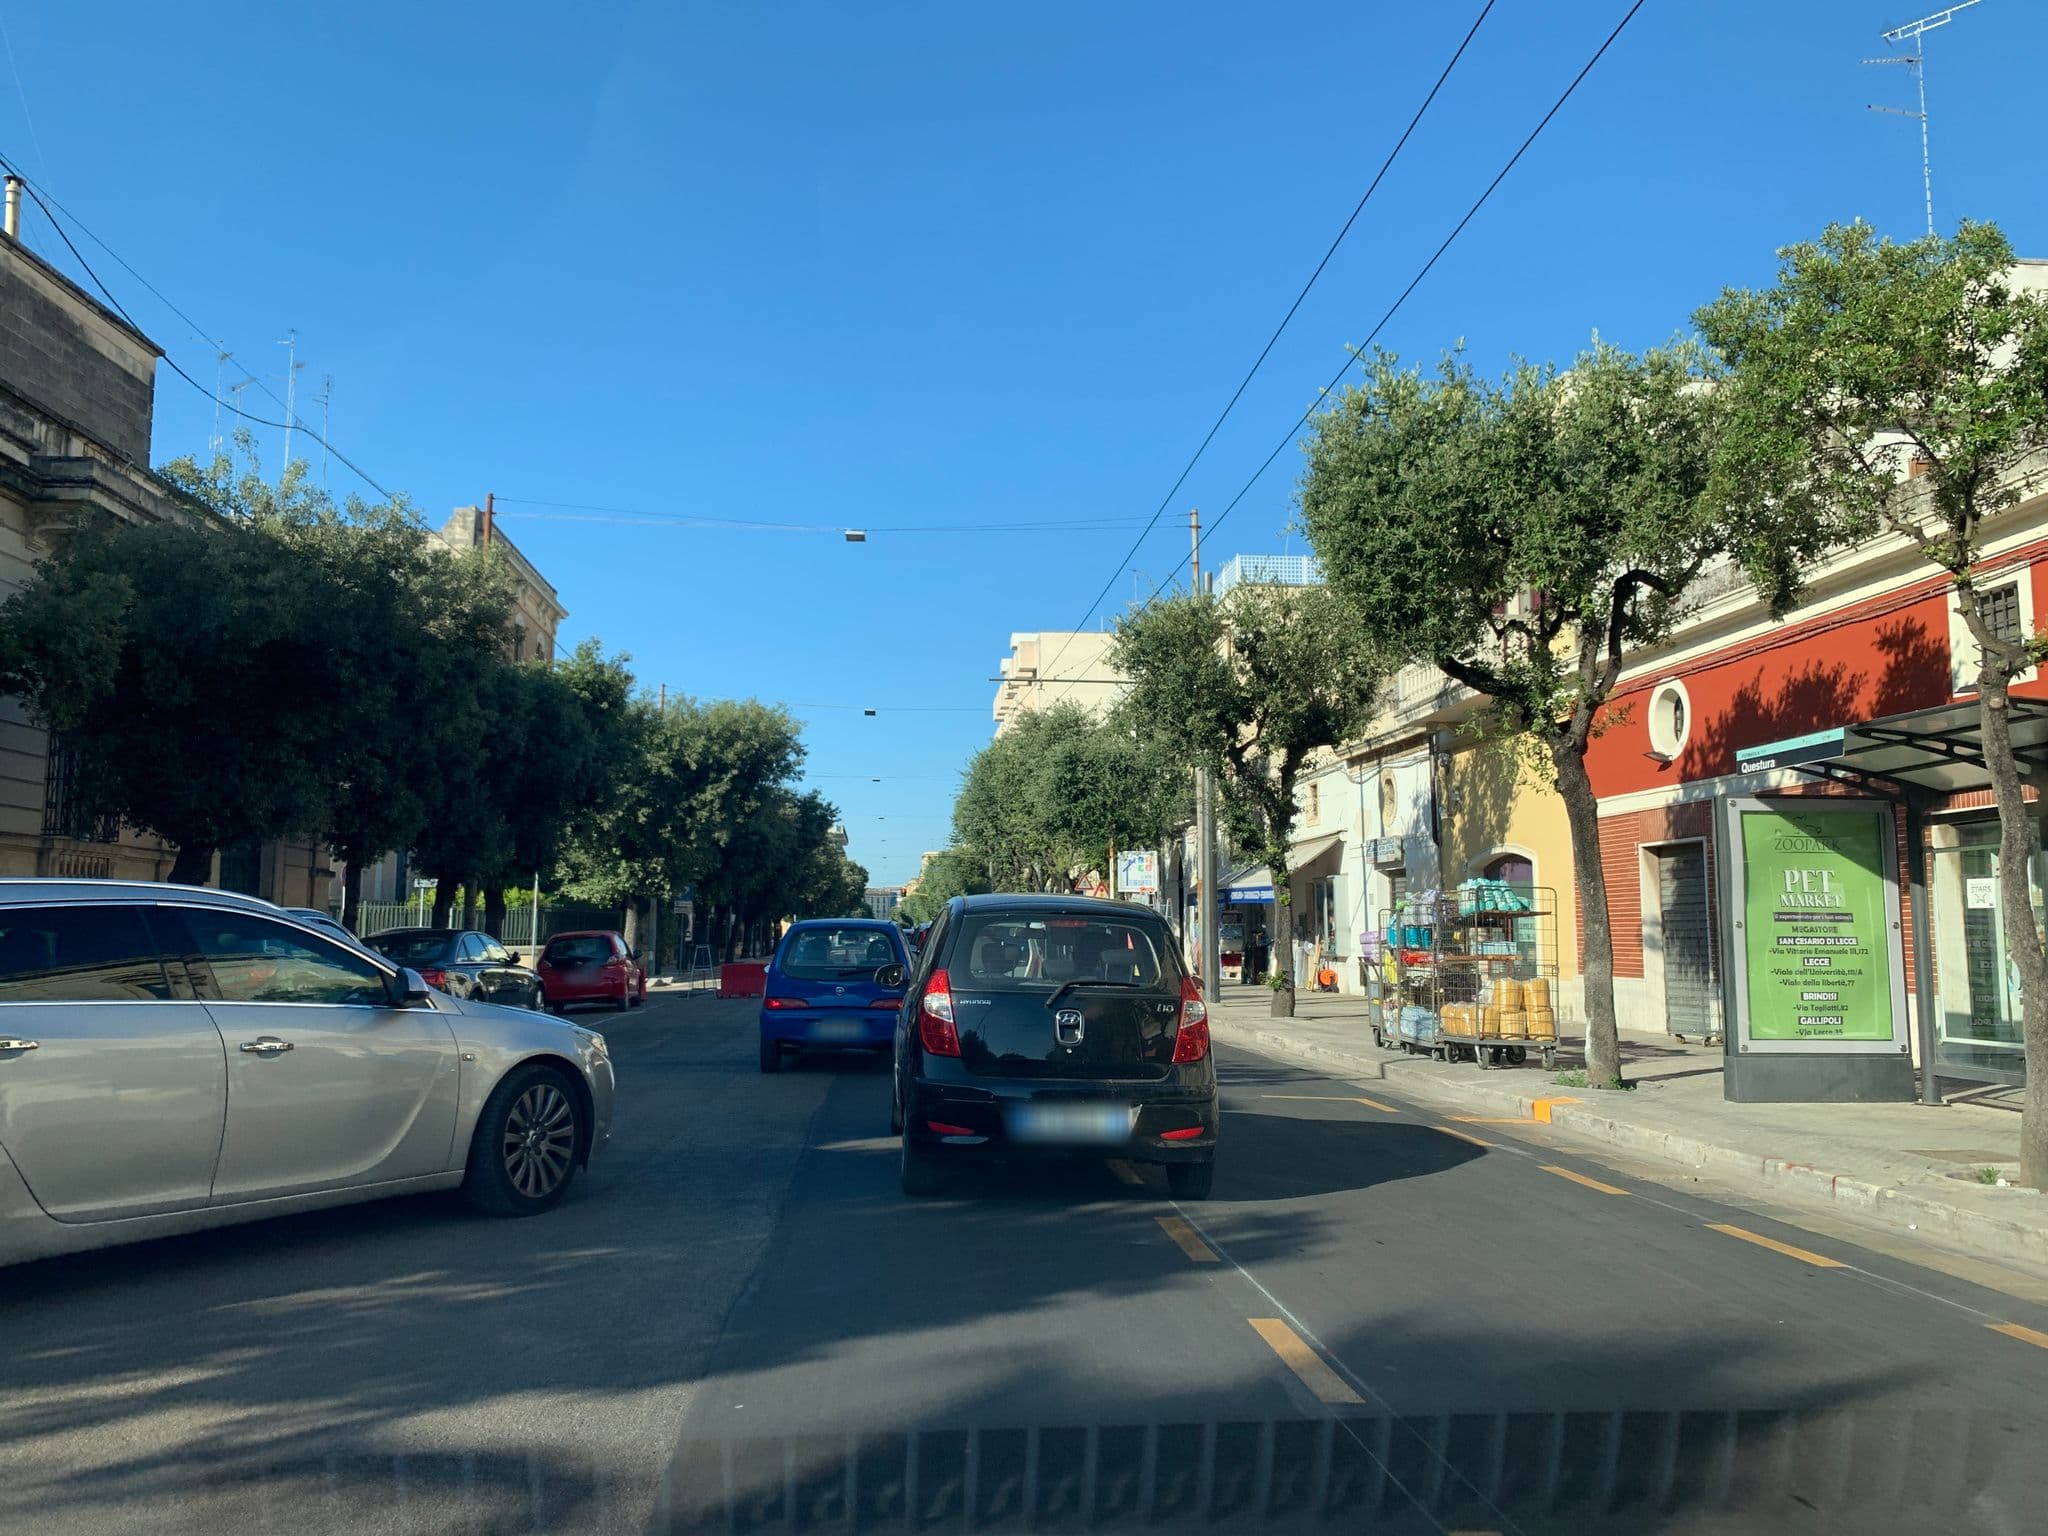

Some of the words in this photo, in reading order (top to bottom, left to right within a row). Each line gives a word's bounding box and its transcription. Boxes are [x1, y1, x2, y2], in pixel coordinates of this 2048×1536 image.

[1741, 759, 1775, 773] Questura
[1774, 838, 1841, 851] ZOOPARK
[1783, 869, 1835, 893] PET
[1779, 894, 1842, 908] MARKET
[1804, 958, 1830, 966] LECCE
[1802, 992, 1837, 1000] BRINDISI
